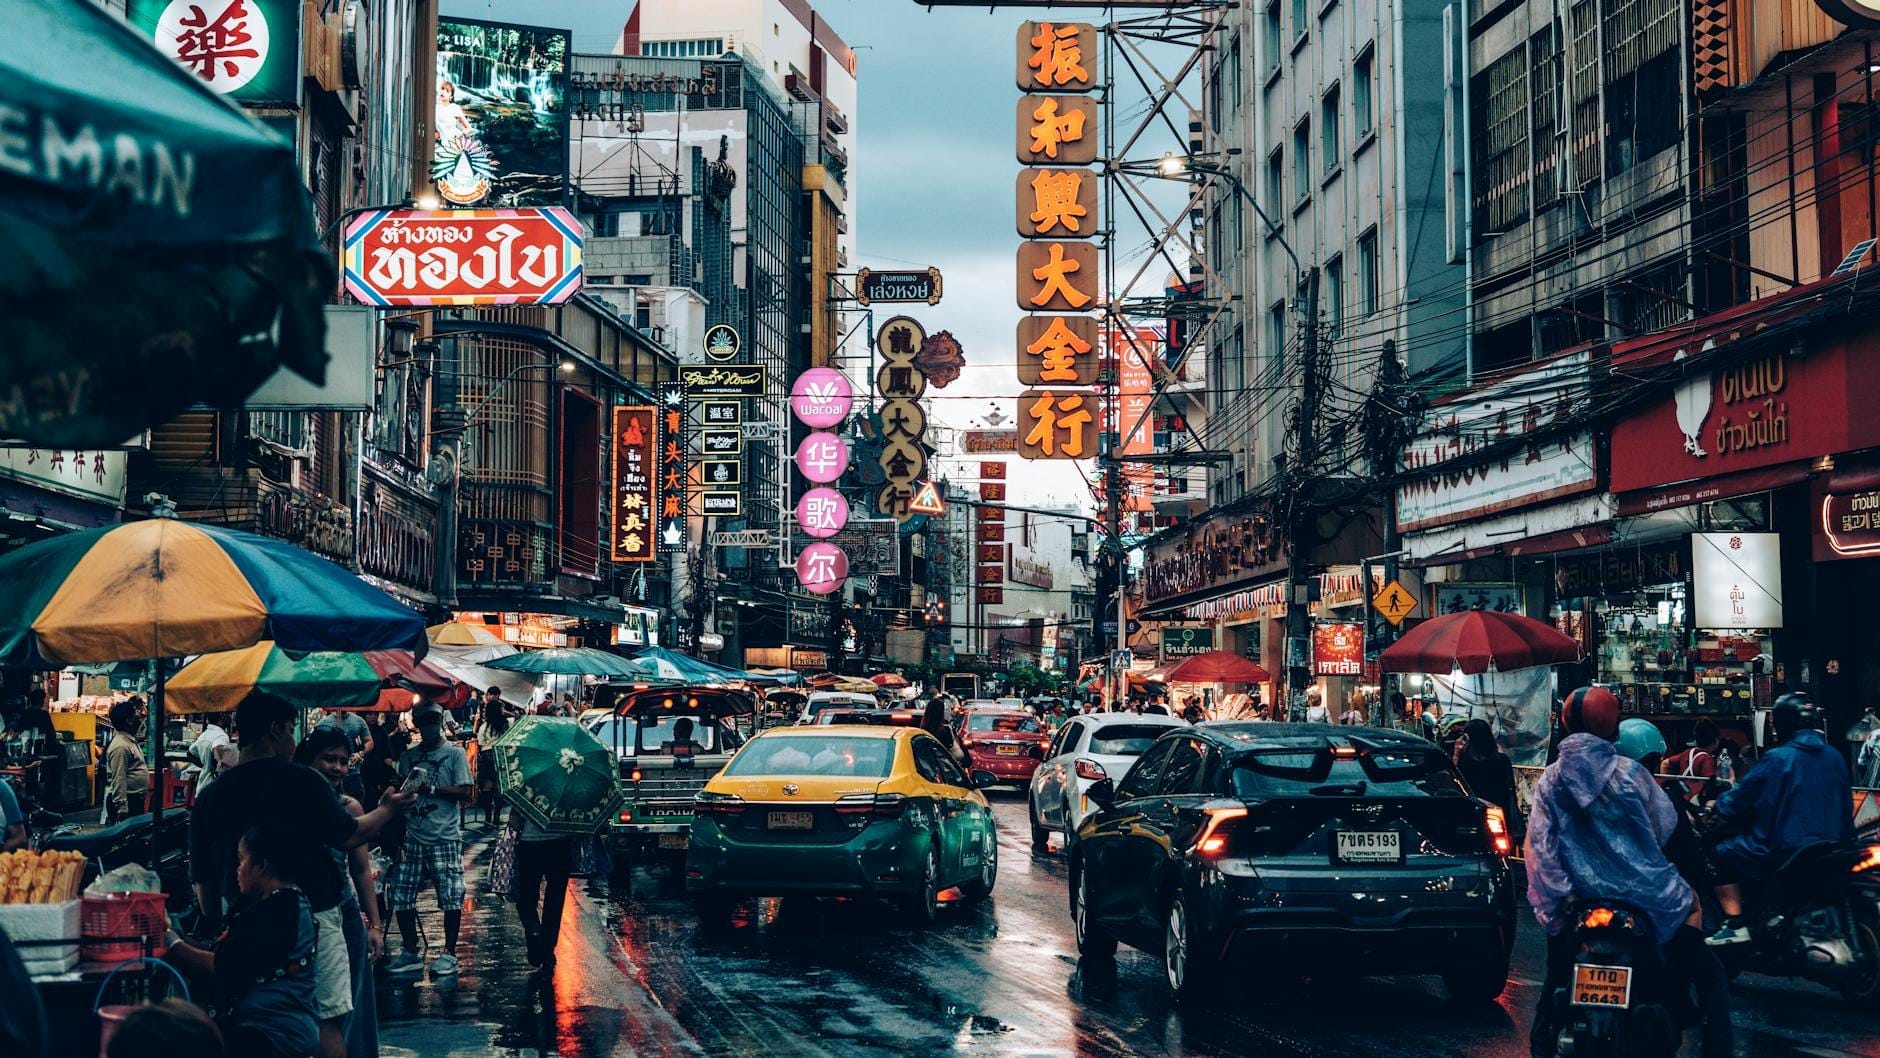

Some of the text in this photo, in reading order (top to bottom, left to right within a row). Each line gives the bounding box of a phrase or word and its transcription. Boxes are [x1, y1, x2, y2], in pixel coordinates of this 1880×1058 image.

[454, 34, 481, 48] LISA
[380, 219, 474, 245] ห้างทอง
[1025, 22, 1093, 457] 振和興大金行
[869, 281, 928, 299] เล่งหงษ์
[801, 405, 843, 415] Wacoal
[1716, 398, 1788, 454] ข้าวมันไก่
[806, 442, 838, 584] 华歌尔
[1580, 992, 1620, 1004] 6643
